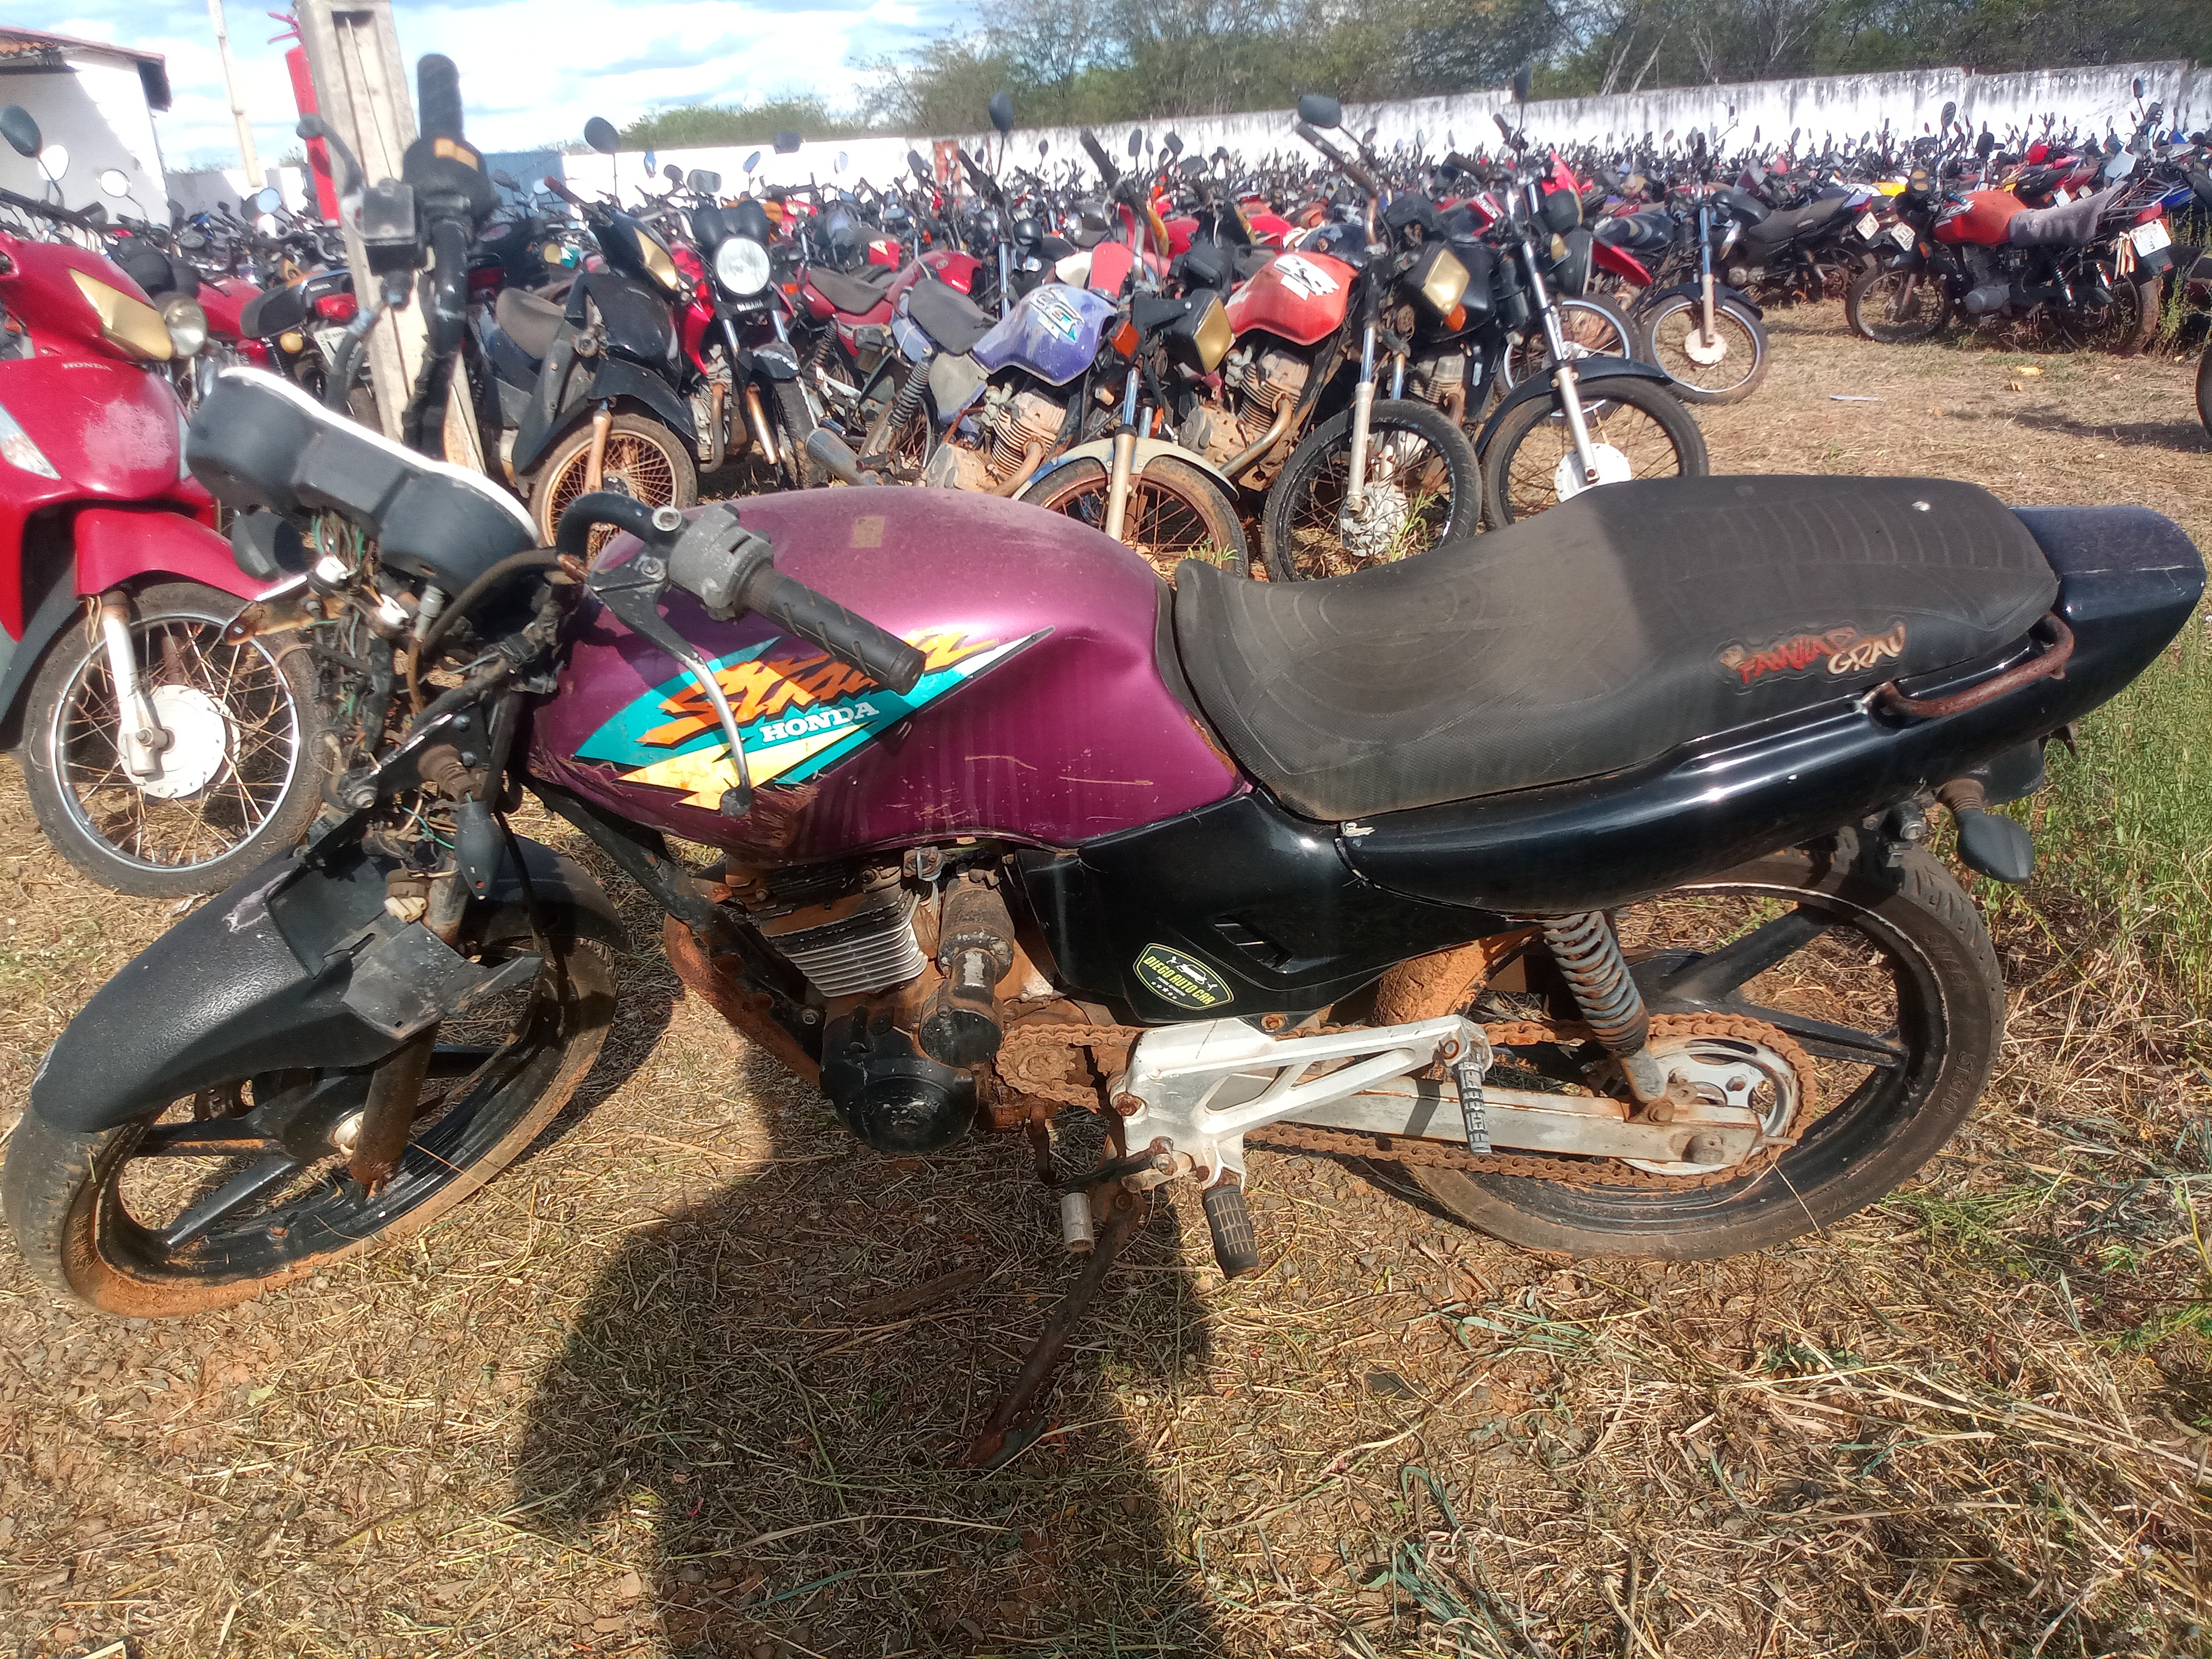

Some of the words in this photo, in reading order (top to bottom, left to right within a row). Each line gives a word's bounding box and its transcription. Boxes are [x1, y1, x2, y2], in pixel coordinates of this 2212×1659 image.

[736, 299, 764, 312] YAMAHA
[61, 362, 113, 372] HONDA
[1827, 625, 1906, 674] GRAU
[759, 701, 880, 743] HONDA
[1143, 955, 1176, 978] DIEGO
[1169, 974, 1198, 993] AUTO
[1192, 989, 1216, 1005] CAR
